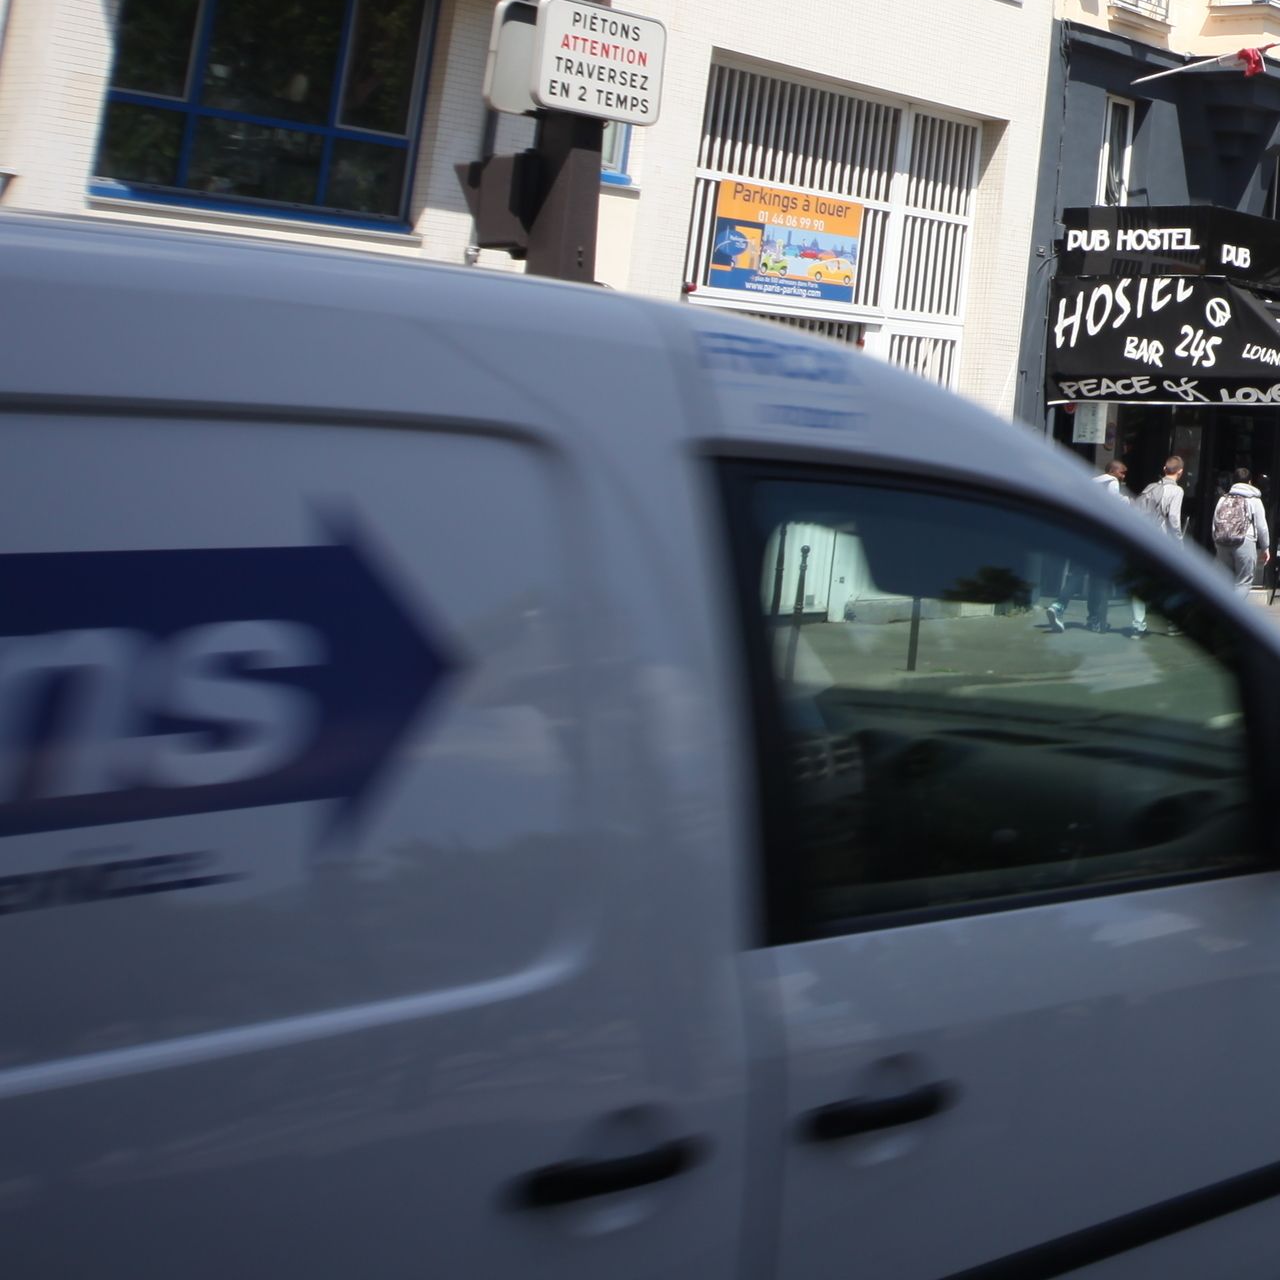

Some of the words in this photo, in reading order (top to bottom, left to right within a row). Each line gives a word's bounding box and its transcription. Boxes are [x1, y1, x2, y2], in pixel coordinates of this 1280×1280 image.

[572, 11, 641, 42] PIÉTONS
[561, 33, 648, 67] ATTENTION
[555, 56, 649, 91] TRAVERSEZ
[548, 79, 571, 99] EN
[577, 86, 588, 102] 2
[596, 89, 650, 114] TEMPS
[733, 182, 798, 213] Parkings
[801, 194, 811, 212] à
[815, 195, 851, 218] louer
[758, 210, 769, 222] 01
[772, 213, 784, 225] 44
[785, 215, 798, 227] 06
[799, 217, 811, 229] 99
[812, 219, 825, 231] 90
[1066, 229, 1110, 251] PUB
[1116, 228, 1200, 251] HOSTEL
[1221, 244, 1251, 269] PUB
[745, 281, 822, 297] www.paris-parking.com
[1124, 336, 1165, 368] BAR
[1174, 324, 1223, 368] 245
[1059, 376, 1157, 398] PEACE
